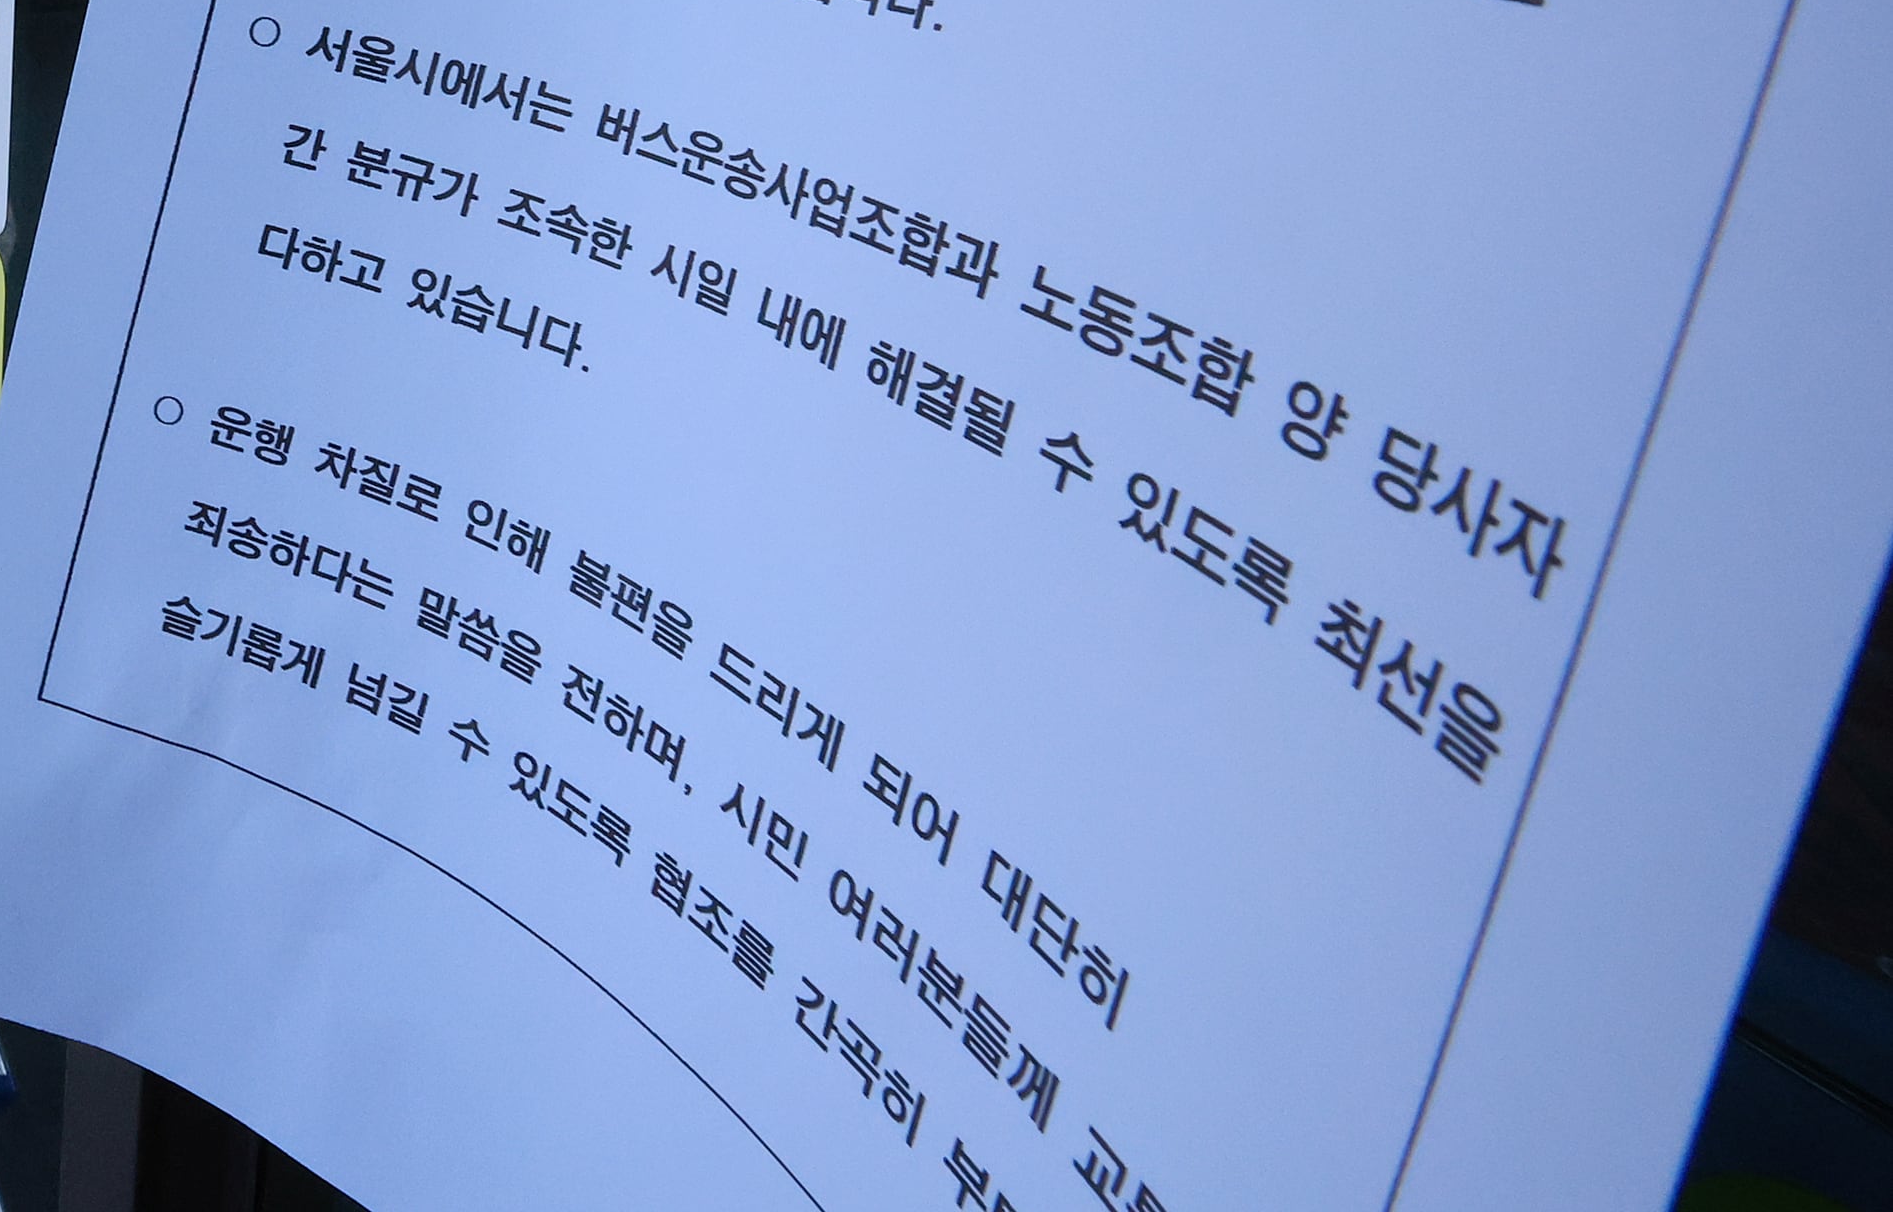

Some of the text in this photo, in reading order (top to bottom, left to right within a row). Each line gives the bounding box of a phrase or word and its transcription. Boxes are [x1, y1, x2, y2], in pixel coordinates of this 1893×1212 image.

[258, 221, 590, 372] 다하고 있습니다.
[282, 123, 1503, 785] 간 분규가 조속한 시일 내에 해결될 수 있도록 최선을
[306, 25, 1565, 600] 서울시에서는 버스운송사업조합과 노동조합 양 당사자
[161, 594, 1017, 1212] 슬기롭게 넘길 수 있도록 협조를 간곡히 부
[184, 499, 394, 609] 죄송하다는
[416, 586, 542, 685] 말씀을
[561, 664, 693, 796] 전하며,
[720, 782, 808, 882] 시민
[828, 868, 1060, 1134] 여러분들께
[210, 404, 1129, 1031] 운행 차질로 인해 불편을 드리게 되어 대단히
